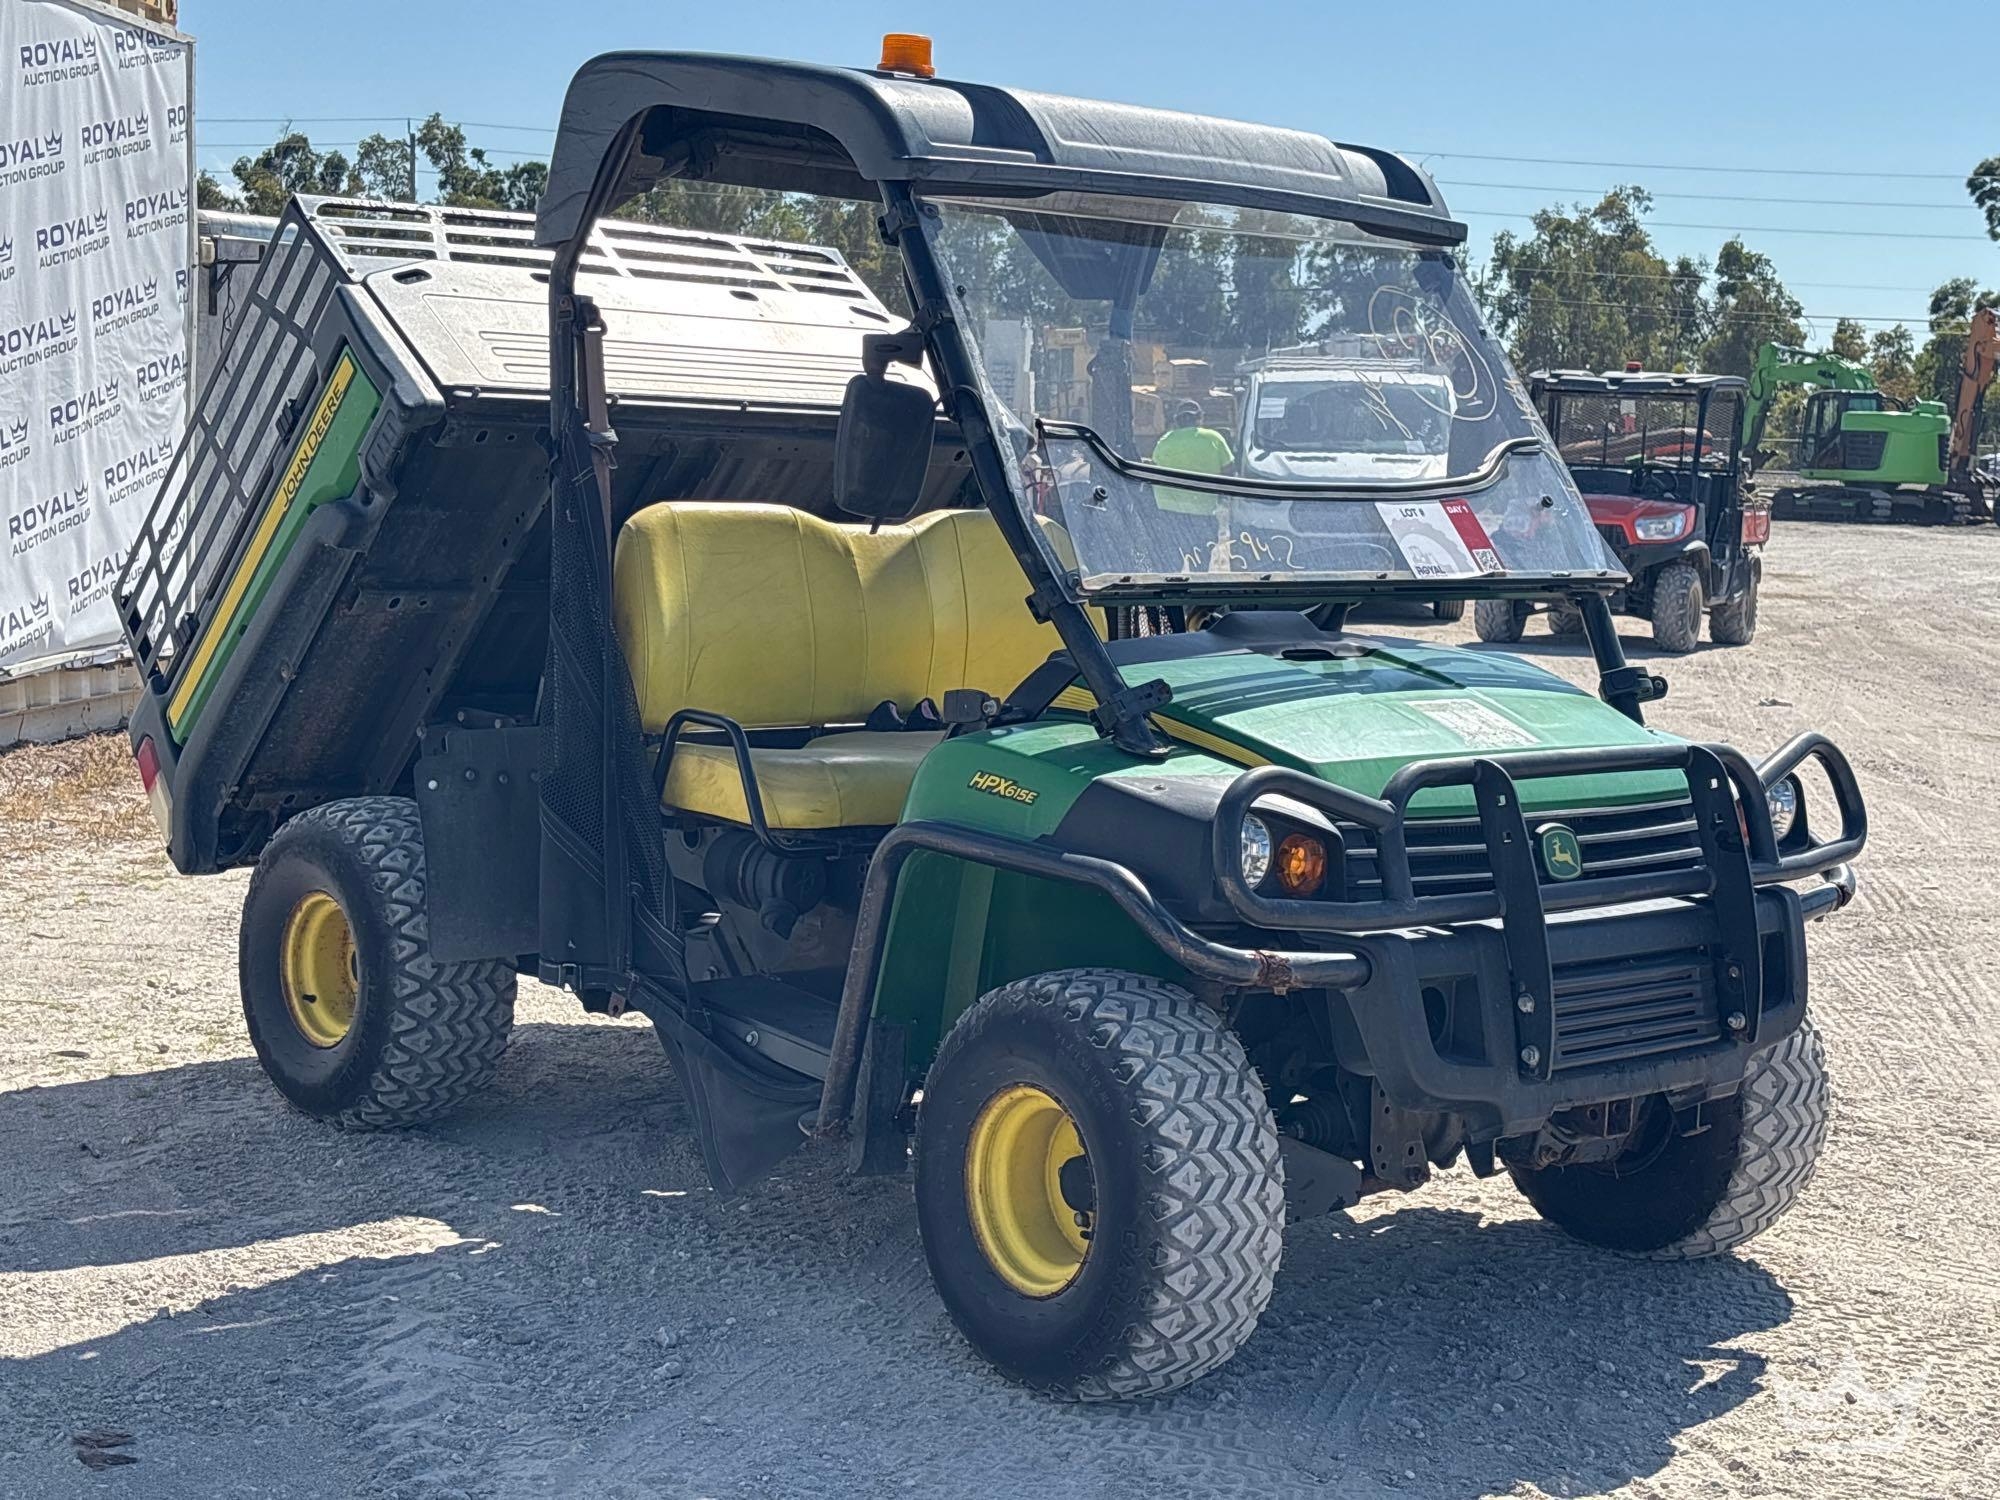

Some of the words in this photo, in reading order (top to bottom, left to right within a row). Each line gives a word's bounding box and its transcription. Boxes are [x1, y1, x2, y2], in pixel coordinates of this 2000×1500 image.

[20, 38, 83, 68] ROYAL
[152, 48, 180, 63] GROUP
[24, 68, 68, 87] AUCTION
[70, 62, 99, 80] GROUP
[82, 117, 136, 148] ROYAL
[0, 138, 45, 168] OYAL
[84, 146, 122, 167] AUCTION
[122, 138, 152, 156] GROUP
[28, 160, 65, 180] GROUP
[126, 190, 180, 224] ROYAL
[36, 215, 94, 252] ROYAL
[127, 218, 163, 239] AUCTION
[164, 213, 188, 228] GRO
[40, 248, 82, 270] AUCTION
[84, 236, 110, 256] GROUP
[92, 284, 145, 322] ROYAL
[94, 315, 130, 340] AUCTION
[130, 303, 160, 324] GROUP
[44, 336, 78, 359] GROUP
[136, 350, 188, 388] ROYAL
[140, 380, 176, 404] AUCTION
[50, 386, 106, 430] ROYAL
[94, 404, 122, 426] GROUP
[0, 446, 30, 469] ROUP
[280, 450, 313, 508] JOHN
[306, 382, 344, 454] DEERE
[104, 448, 158, 490] ROYAL
[109, 476, 144, 506] AUCTION
[146, 466, 169, 486] GRO
[8, 492, 75, 540] ROYAL
[1400, 508, 1418, 518] LOT
[1446, 506, 1461, 514] DAY
[12, 522, 57, 557] AUCTION
[58, 507, 90, 534] GROUP
[68, 552, 127, 601] ROYAL
[1415, 564, 1446, 575] ROYAL
[70, 584, 109, 616] AUCTION
[18, 620, 54, 649] GROUP
[968, 771, 1038, 804] HPX615E
